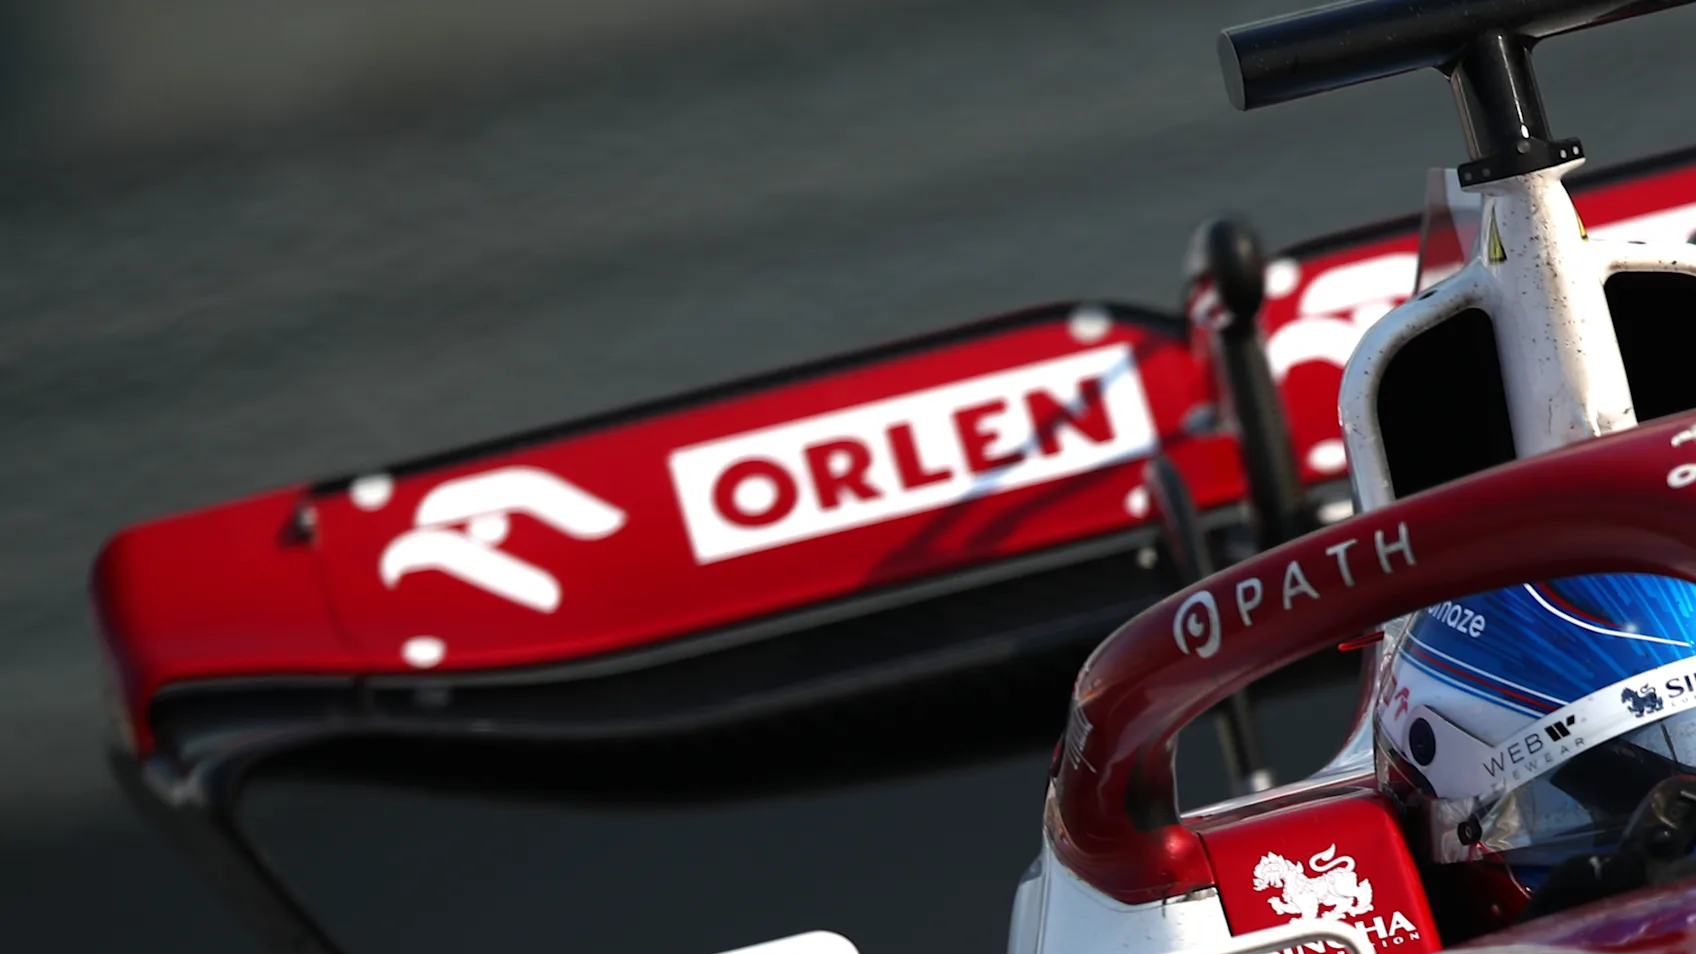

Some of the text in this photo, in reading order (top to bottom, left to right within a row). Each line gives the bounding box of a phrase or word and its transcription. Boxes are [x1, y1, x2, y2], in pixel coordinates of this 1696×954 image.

[712, 377, 1115, 529] ORLEN
[1235, 521, 1416, 626] PATH
[1482, 733, 1544, 777] WEB
